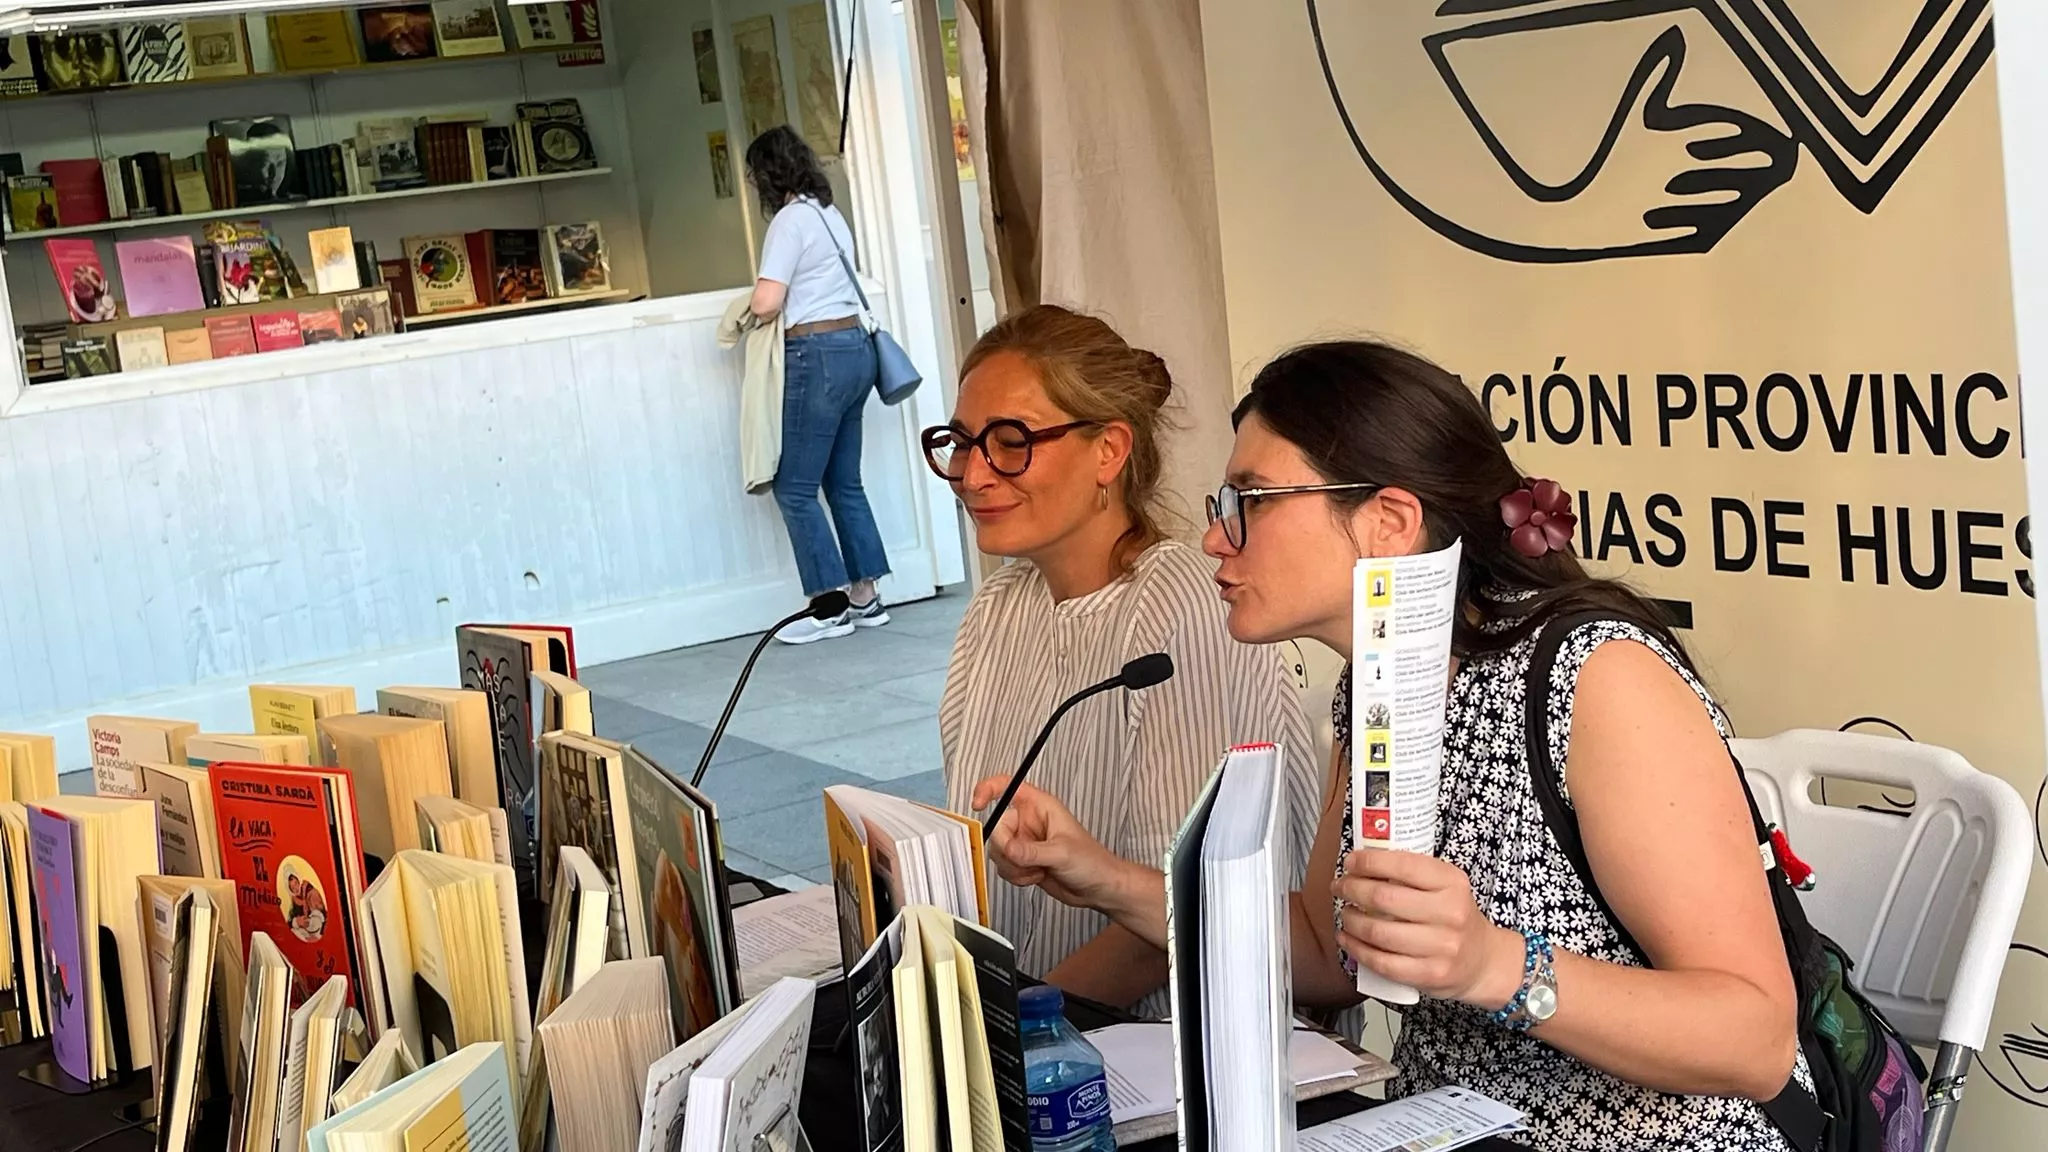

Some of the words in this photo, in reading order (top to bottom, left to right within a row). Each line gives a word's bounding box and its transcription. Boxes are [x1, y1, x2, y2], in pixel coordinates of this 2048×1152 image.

[559, 48, 603, 63] EXTINTOR
[134, 251, 183, 264] mandalas
[1481, 356, 1632, 446] CIÓN
[1656, 372, 2026, 460] PROVINC
[1572, 490, 1687, 568] IAS
[1711, 496, 1811, 580] DE
[92, 728, 121, 744] Victoria
[94, 741, 120, 757] Camps
[96, 754, 106, 767] La
[98, 768, 107, 778] de
[108, 770, 115, 781] la
[222, 780, 272, 795] CRISTINA
[1078, 1084, 1100, 1098] MONTE
[1027, 1096, 1050, 1107] ODIO
